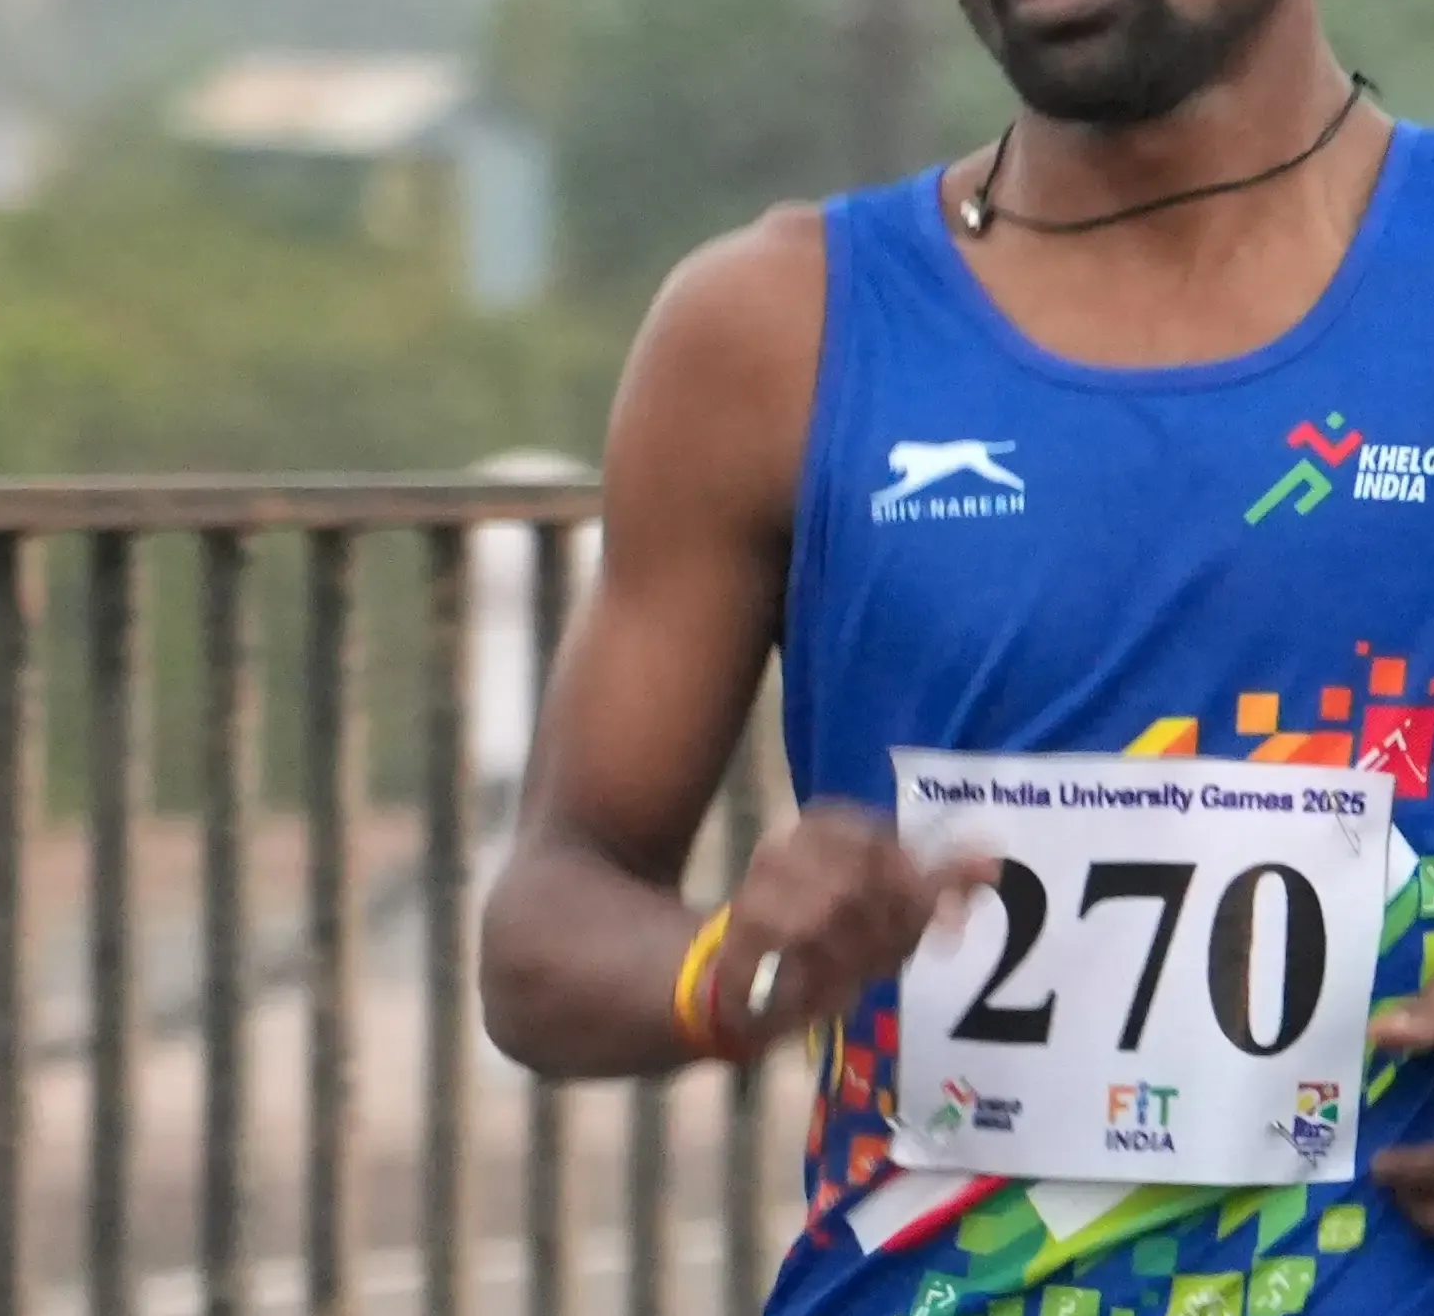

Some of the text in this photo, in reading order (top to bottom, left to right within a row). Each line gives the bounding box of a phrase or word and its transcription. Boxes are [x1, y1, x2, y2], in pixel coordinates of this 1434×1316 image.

[1353, 472, 1426, 502] INDIA
[992, 778, 1051, 807] India
[1059, 781, 1193, 814] University
[1201, 784, 1293, 811] Games
[949, 857, 1327, 1057] 270
[1106, 1130, 1176, 1154] INDIA
